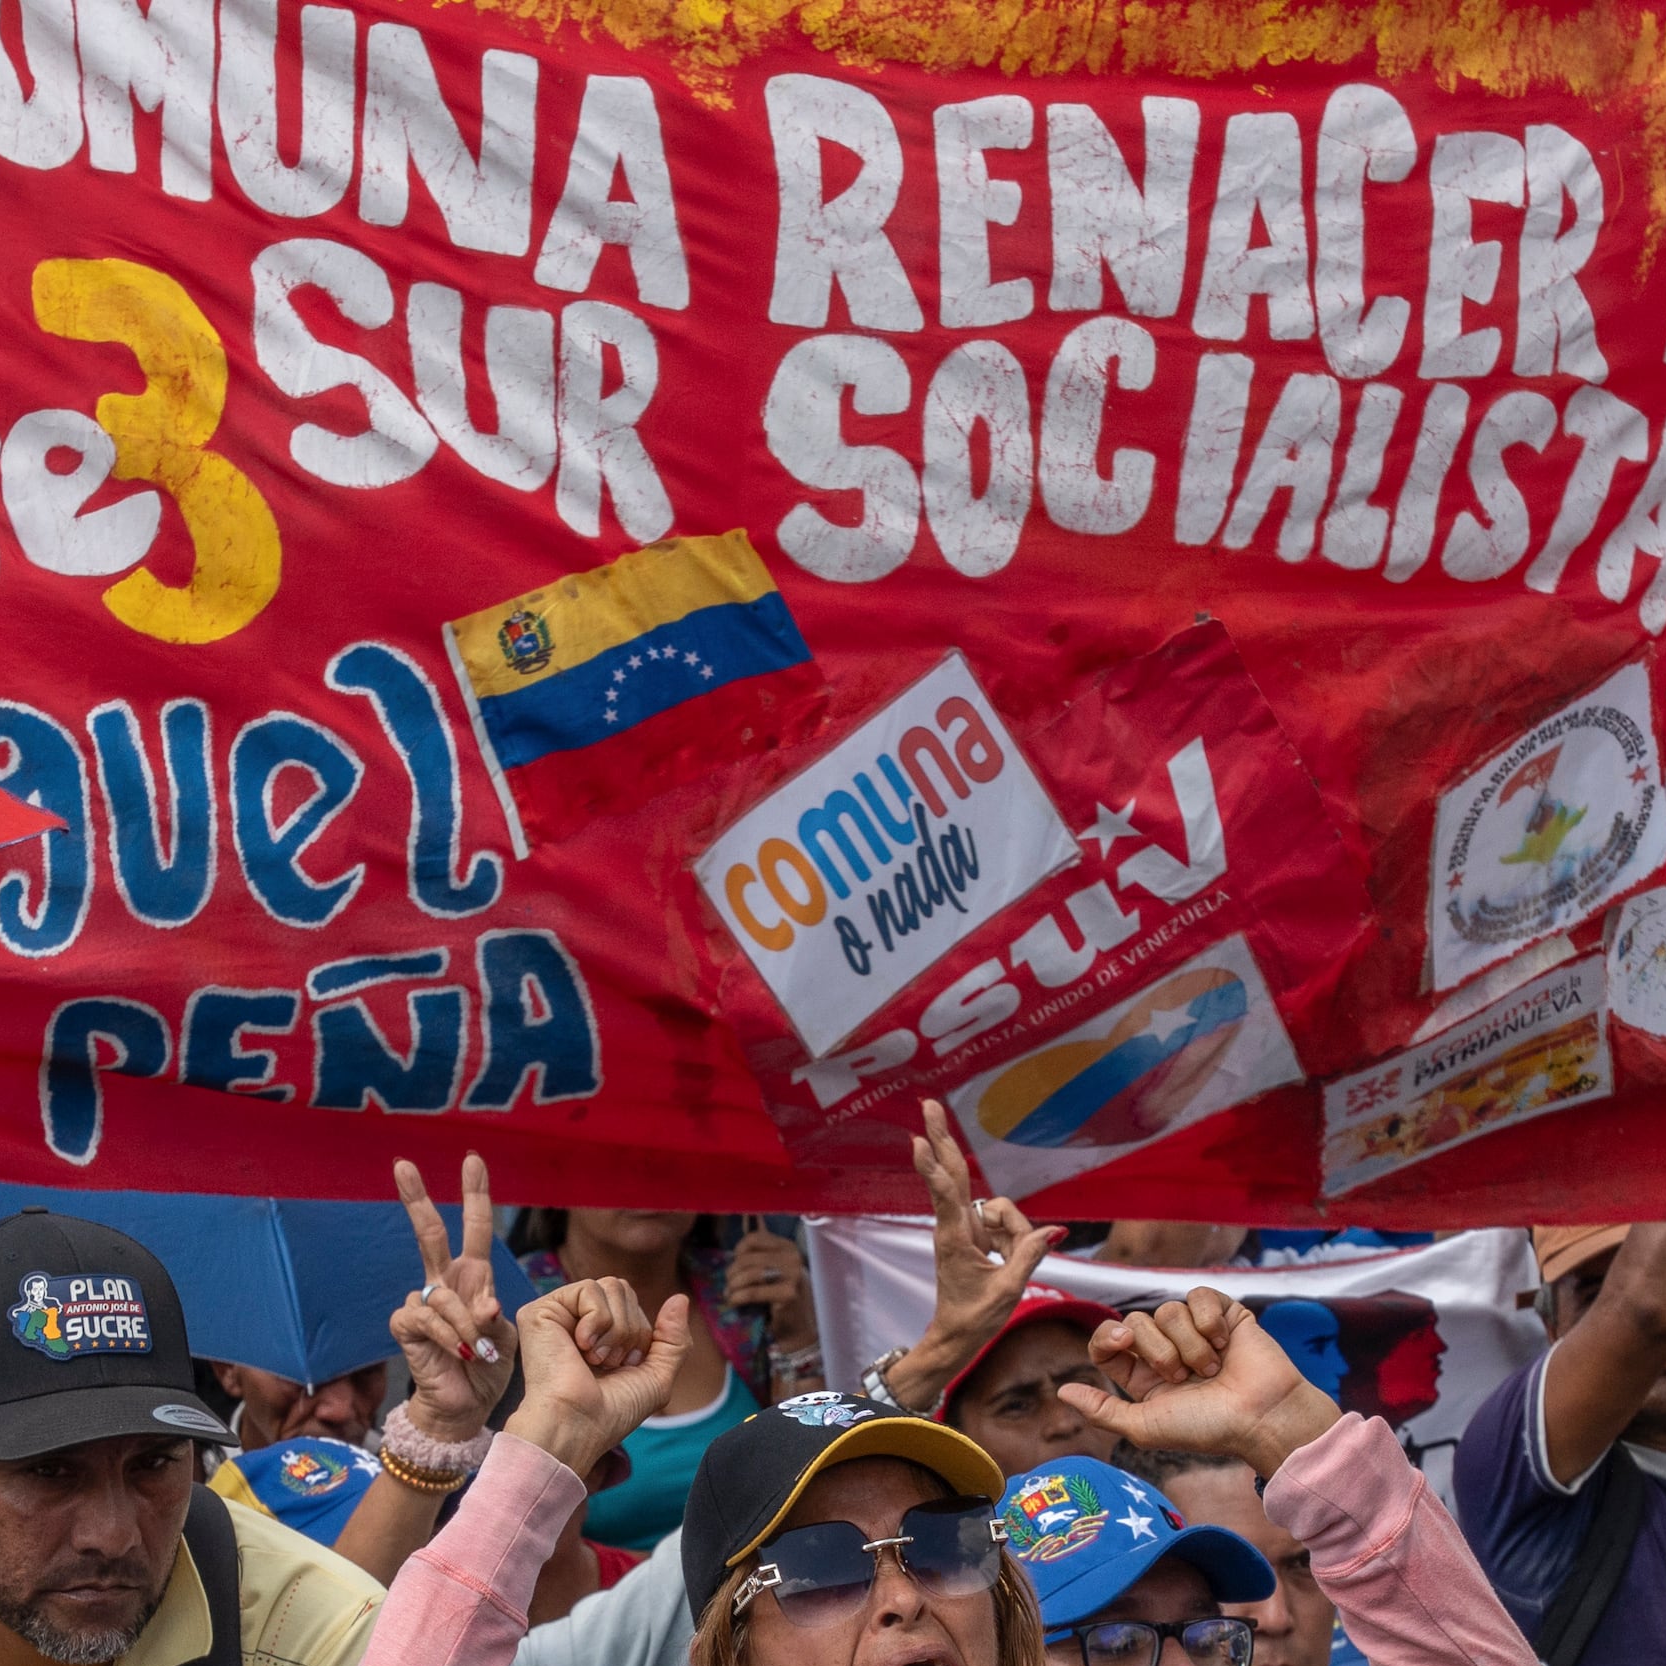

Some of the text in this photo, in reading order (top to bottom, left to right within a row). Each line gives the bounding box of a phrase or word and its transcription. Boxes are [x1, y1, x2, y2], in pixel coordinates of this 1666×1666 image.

[764, 73, 1609, 385] RENACER
[31, 256, 282, 644] 3
[251, 239, 674, 544] SUR
[725, 695, 1005, 952] comuna
[833, 800, 980, 976] o nada
[40, 928, 603, 1165] PEÑA
[824, 890, 1231, 1129] PARTIDO SOCIALISTA UNIDO DE VENEZUELA
[65, 1315, 148, 1342] SUCRE
[66, 1300, 141, 1315] ANTONIO JOSÉ DE
[70, 1278, 133, 1302] PLAN
